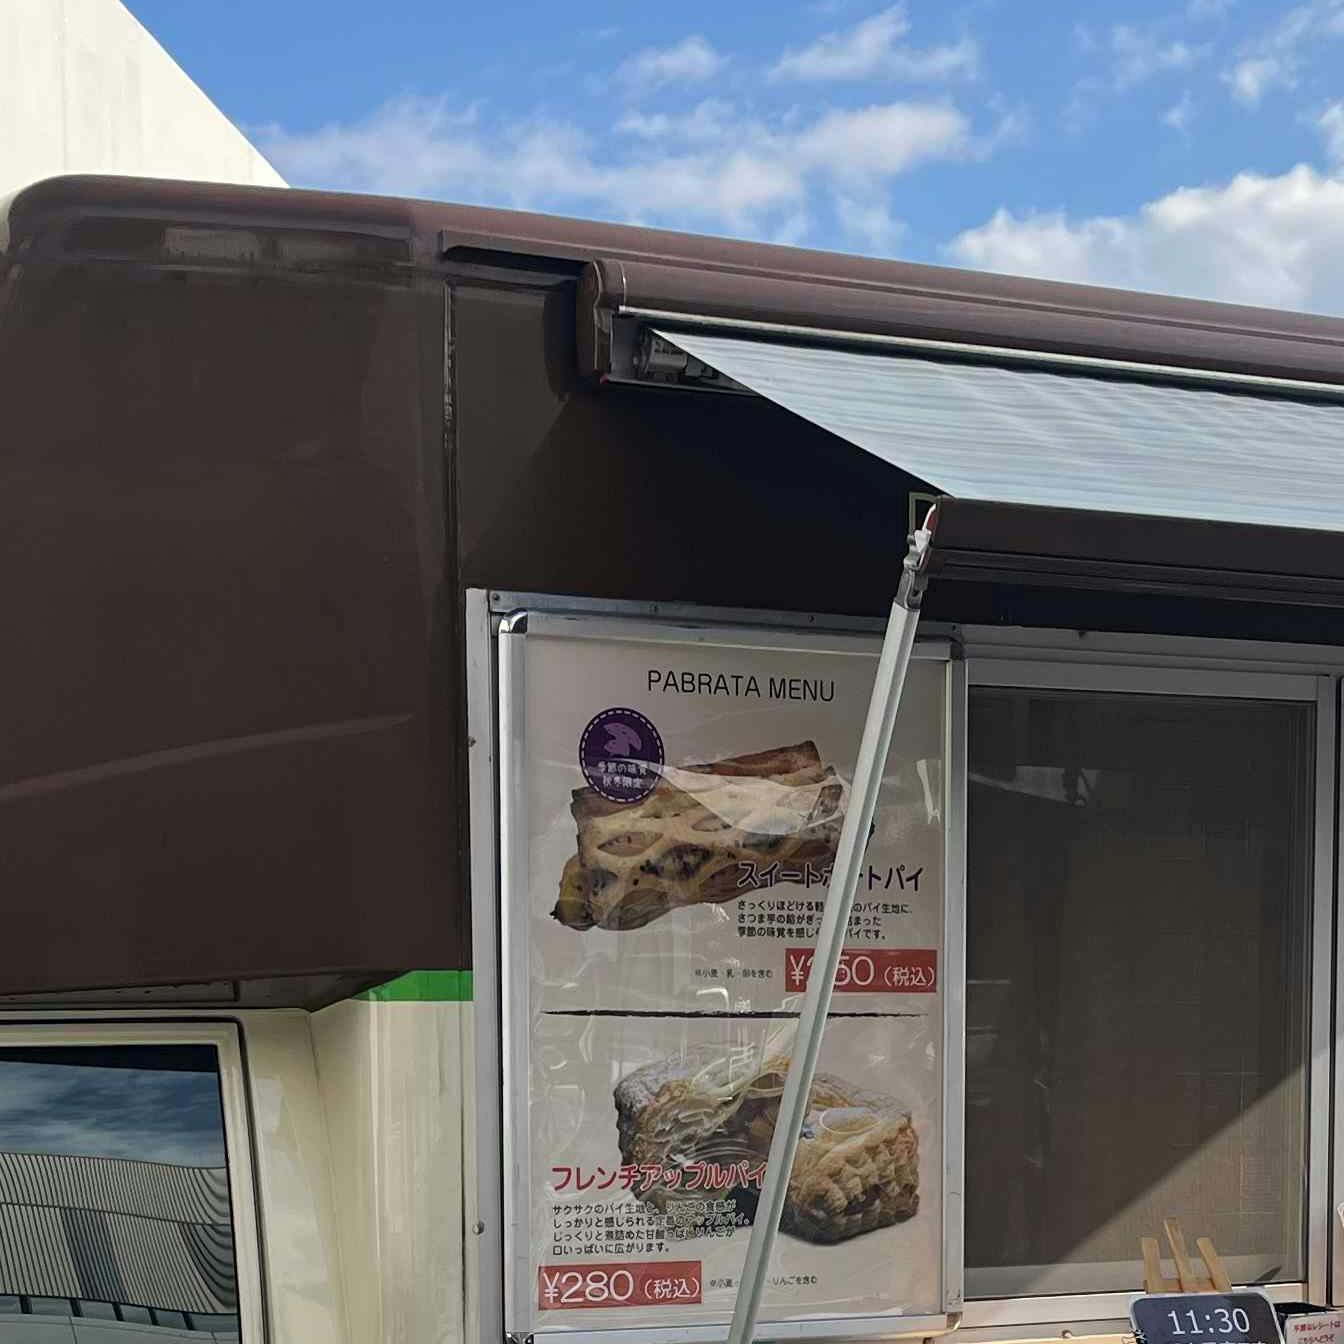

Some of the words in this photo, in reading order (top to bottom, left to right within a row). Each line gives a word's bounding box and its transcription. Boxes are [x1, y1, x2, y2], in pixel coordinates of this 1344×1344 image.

[647, 669, 761, 698] PABRATA
[768, 677, 836, 702] MENU
[737, 861, 924, 891] スイートトパイ
[789, 955, 875, 987] ¥50
[551, 1160, 769, 1193] フレンチアップルパイ
[543, 1269, 634, 1304] ¥280
[1167, 1308, 1251, 1335] 11:30
